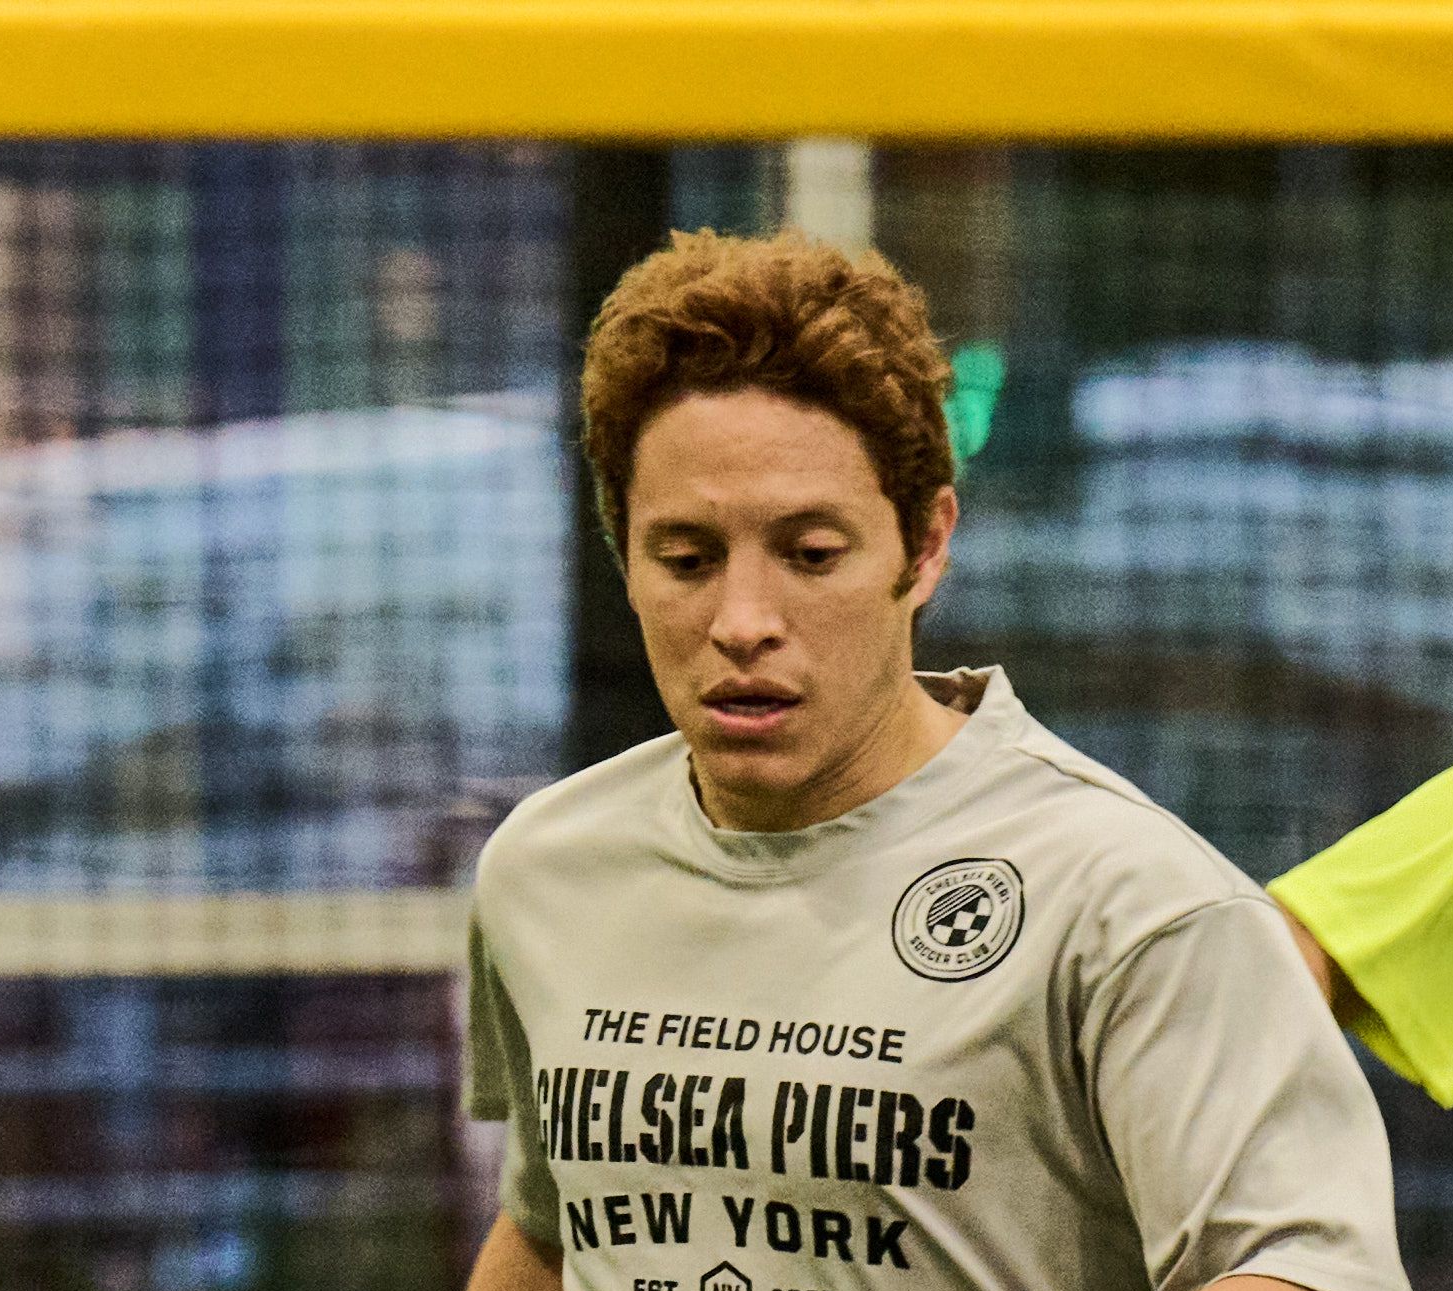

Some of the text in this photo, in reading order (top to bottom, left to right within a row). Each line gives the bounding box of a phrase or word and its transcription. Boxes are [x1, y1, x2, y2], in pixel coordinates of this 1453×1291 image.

[583, 1008, 906, 1064] THE FIELD HOUSE
[770, 1081, 976, 1192] PIERS
[565, 1192, 911, 1271] NEW YORK
